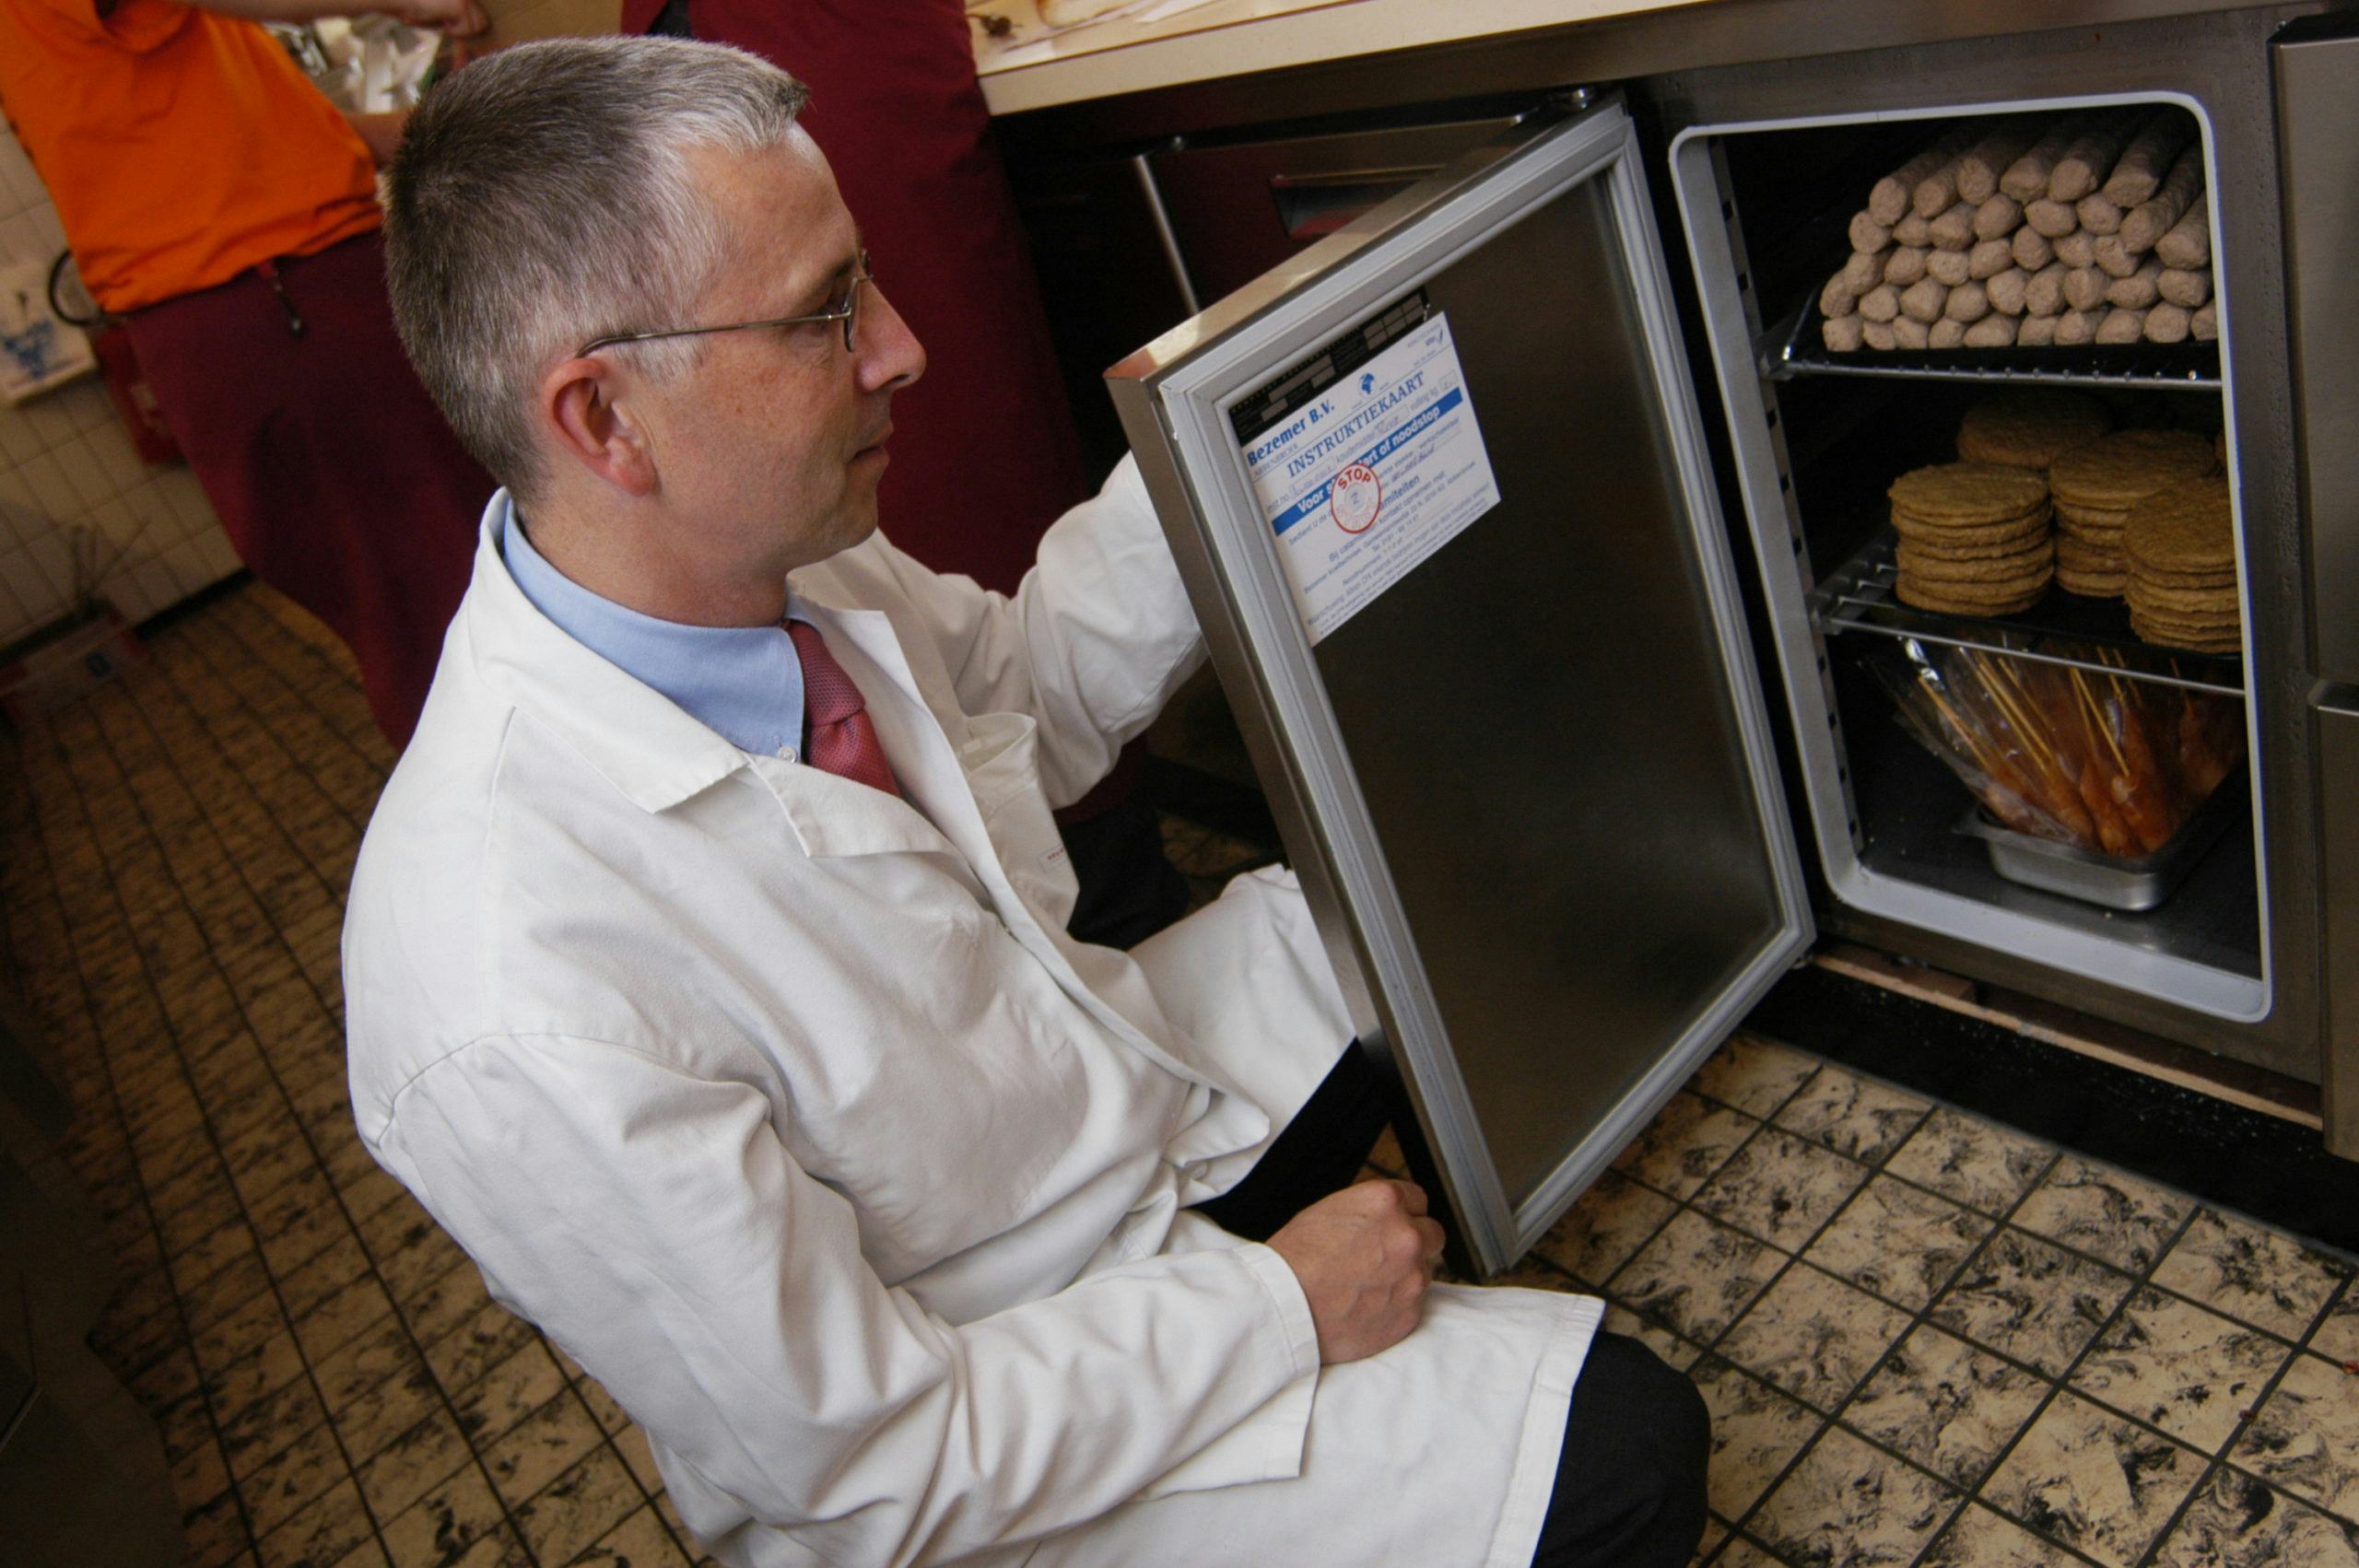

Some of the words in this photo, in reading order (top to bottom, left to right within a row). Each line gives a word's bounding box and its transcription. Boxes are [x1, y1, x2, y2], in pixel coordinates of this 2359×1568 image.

[1246, 415, 1307, 466] Bezemer
[1309, 396, 1334, 424] B.V.
[1286, 369, 1426, 478] INSTRUKTIEKAART
[1297, 486, 1325, 514] Voor
[1378, 439, 1391, 456] of
[1391, 404, 1440, 447] noodstop
[1338, 468, 1371, 490] STOP
